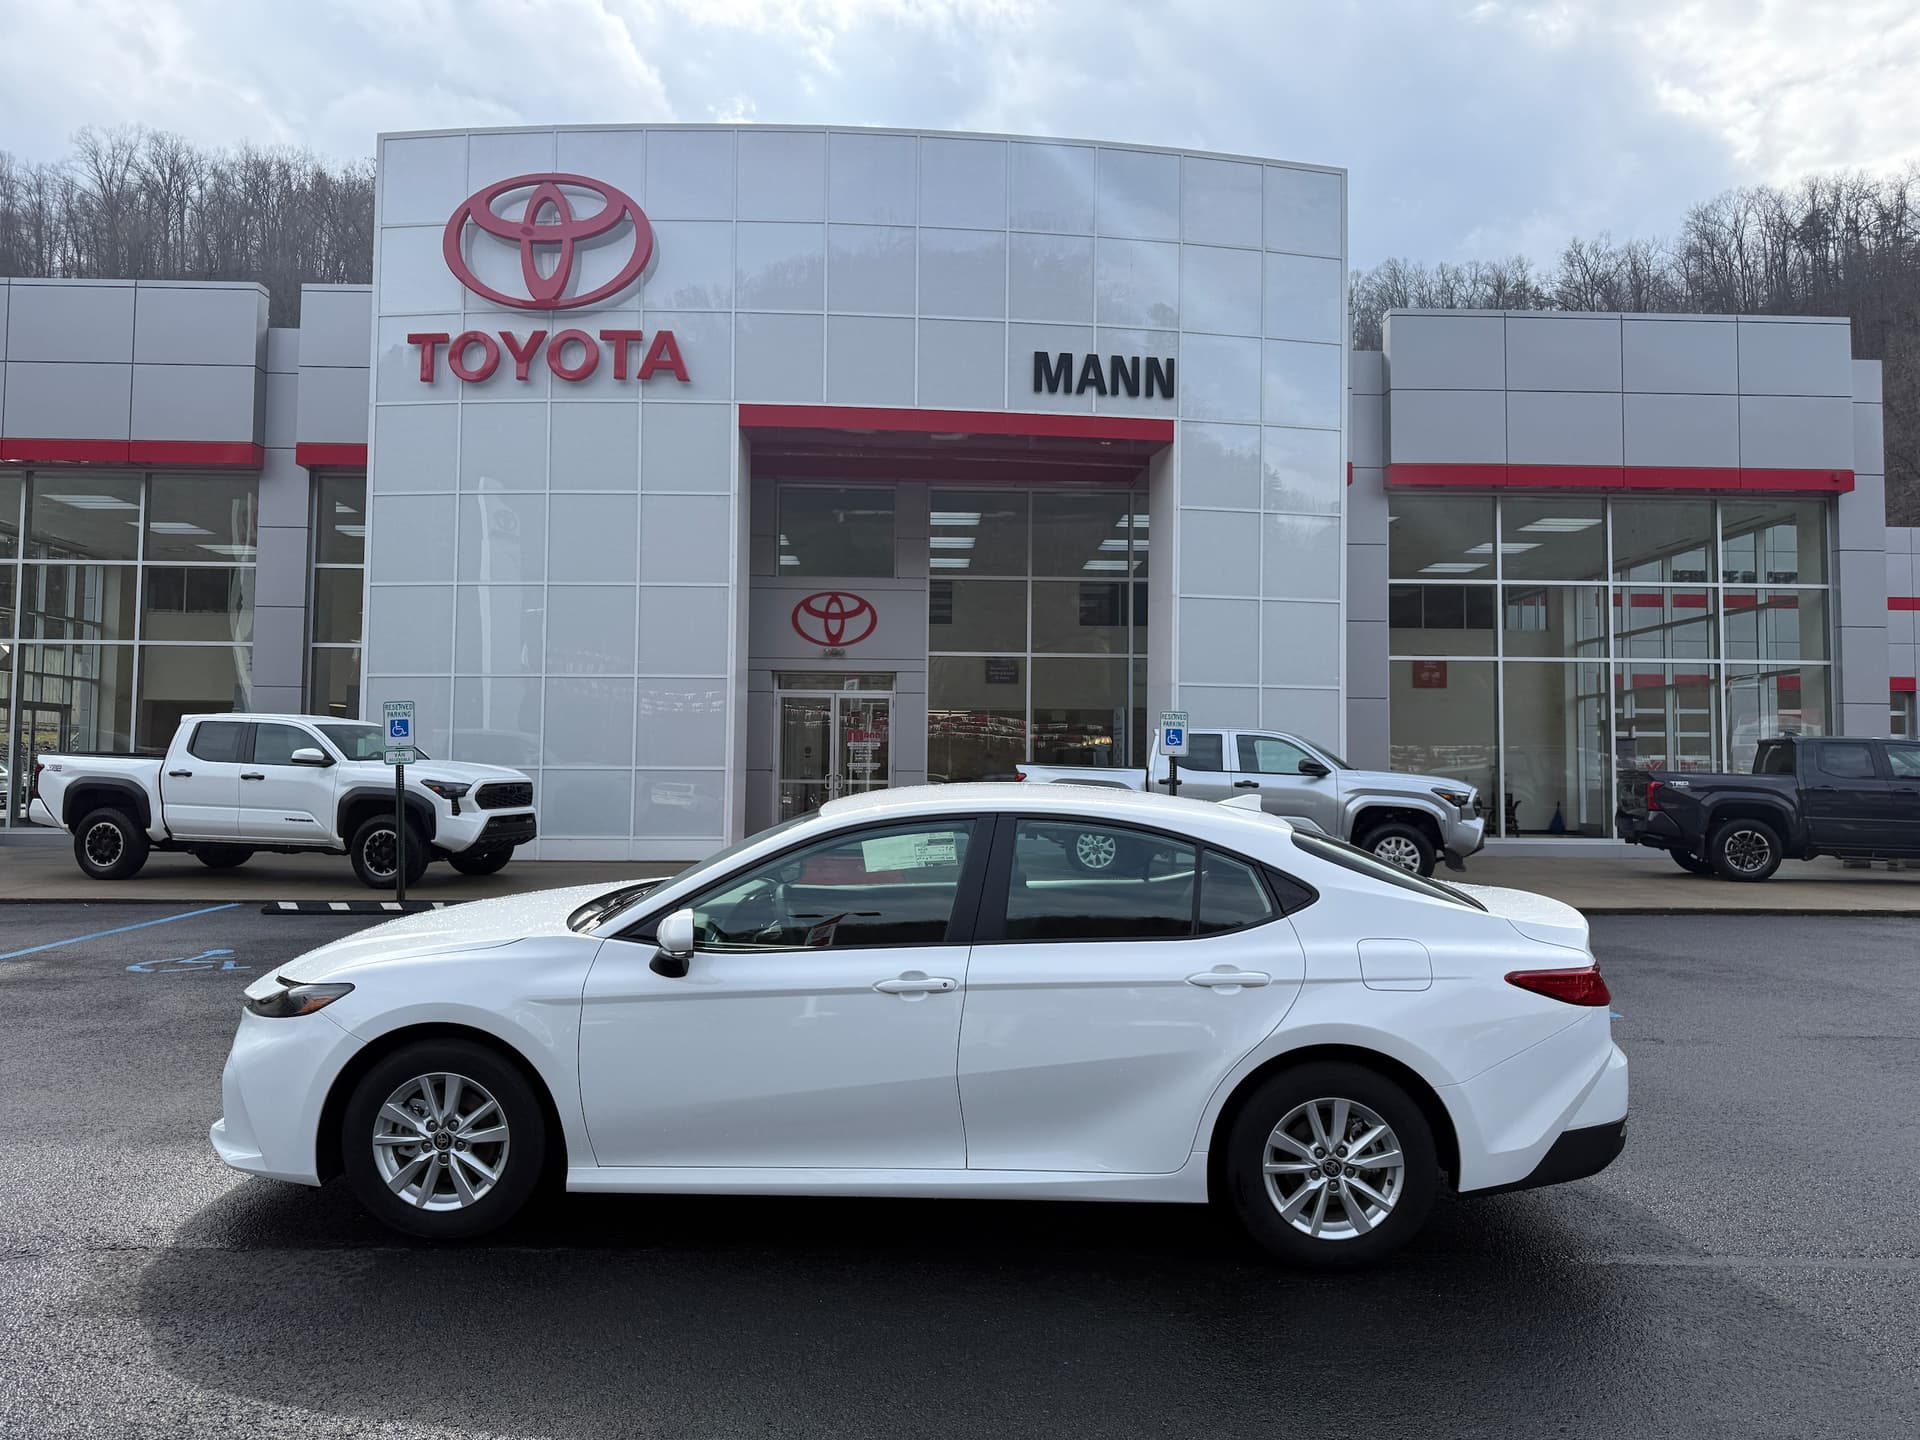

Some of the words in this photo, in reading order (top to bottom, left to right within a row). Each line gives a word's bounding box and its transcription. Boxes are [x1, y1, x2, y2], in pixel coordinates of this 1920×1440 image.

[407, 329, 691, 383] TOYOTA
[1033, 351, 1175, 398] MANN
[384, 703, 413, 711] RESERVED
